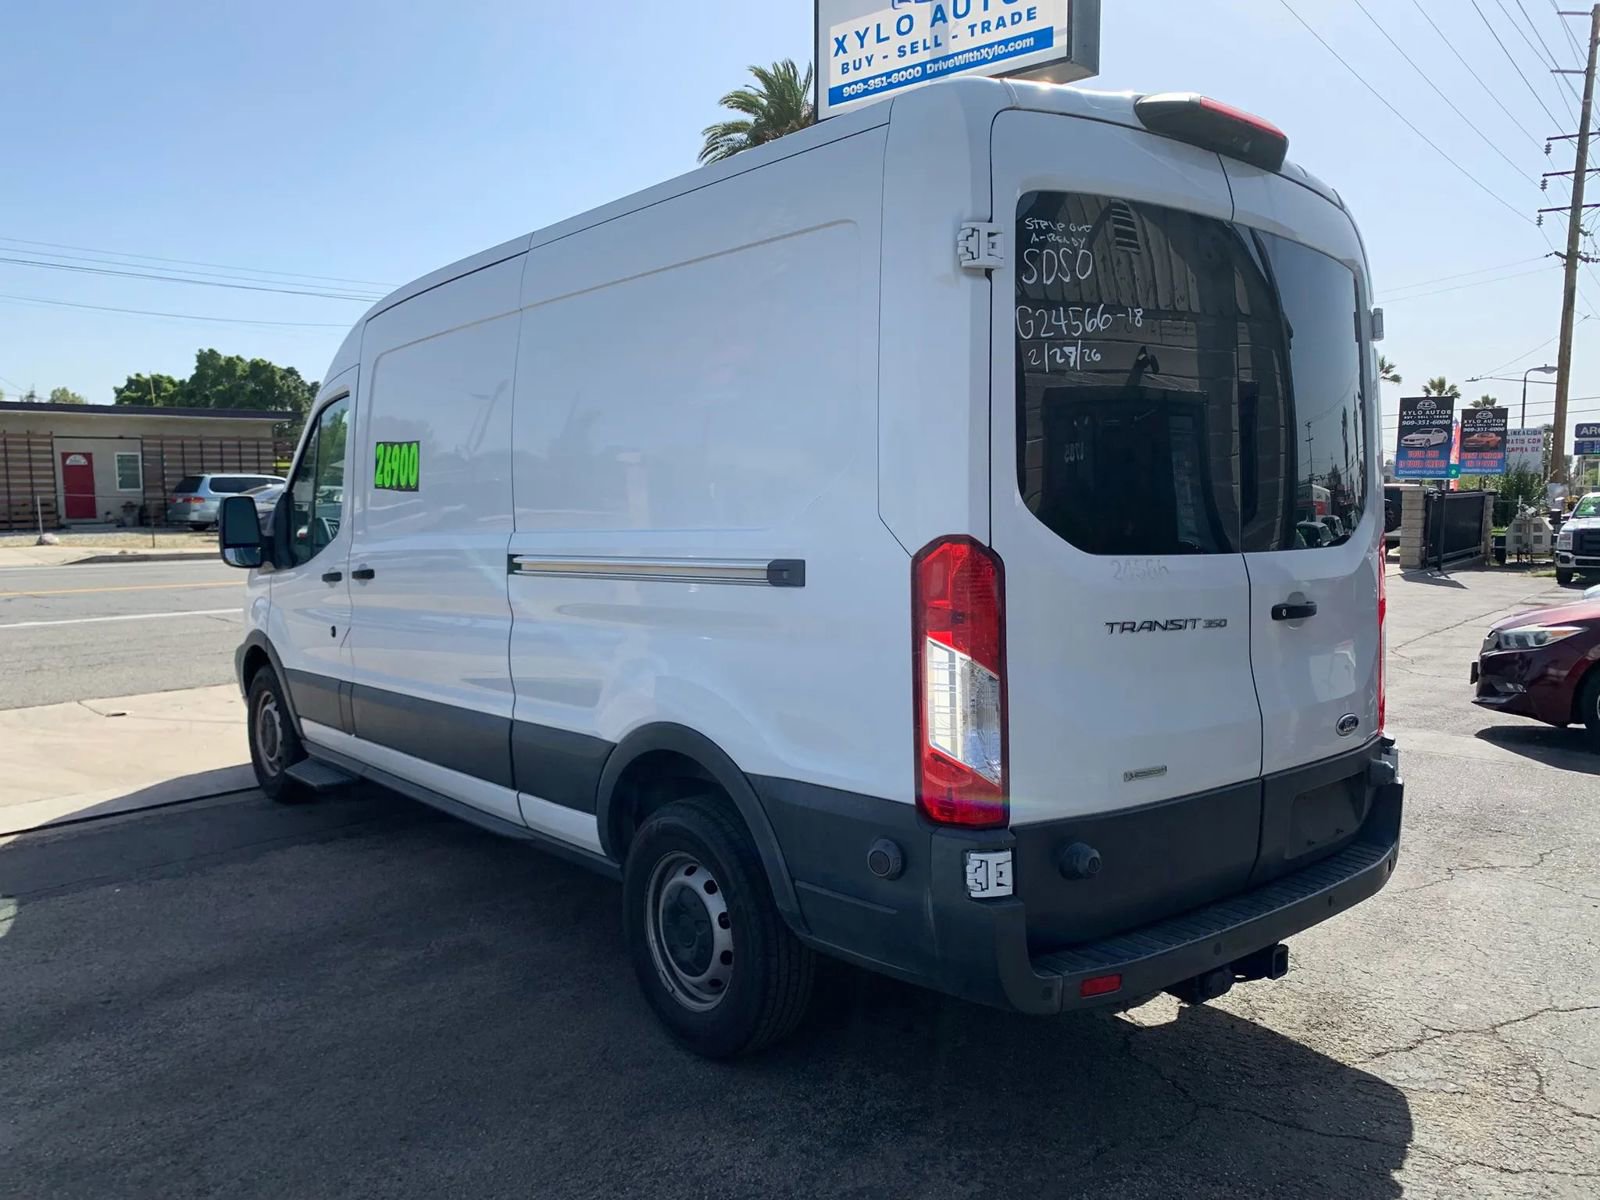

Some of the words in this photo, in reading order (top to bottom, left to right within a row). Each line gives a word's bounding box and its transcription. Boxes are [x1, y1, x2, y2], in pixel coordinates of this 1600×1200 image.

[834, 14, 914, 57] XYLO
[841, 54, 874, 75] BUY
[897, 35, 943, 58] SELL
[968, 7, 1037, 37] TRADE
[842, 66, 922, 97] 909-351-6000
[926, 36, 1035, 74] DriveWithXylo.com
[1022, 248, 1093, 285] SDSO
[1016, 303, 1143, 339] G24566-18
[375, 442, 418, 489] 26900
[1105, 617, 1201, 634] TRANSIT
[1202, 618, 1228, 629] 350
